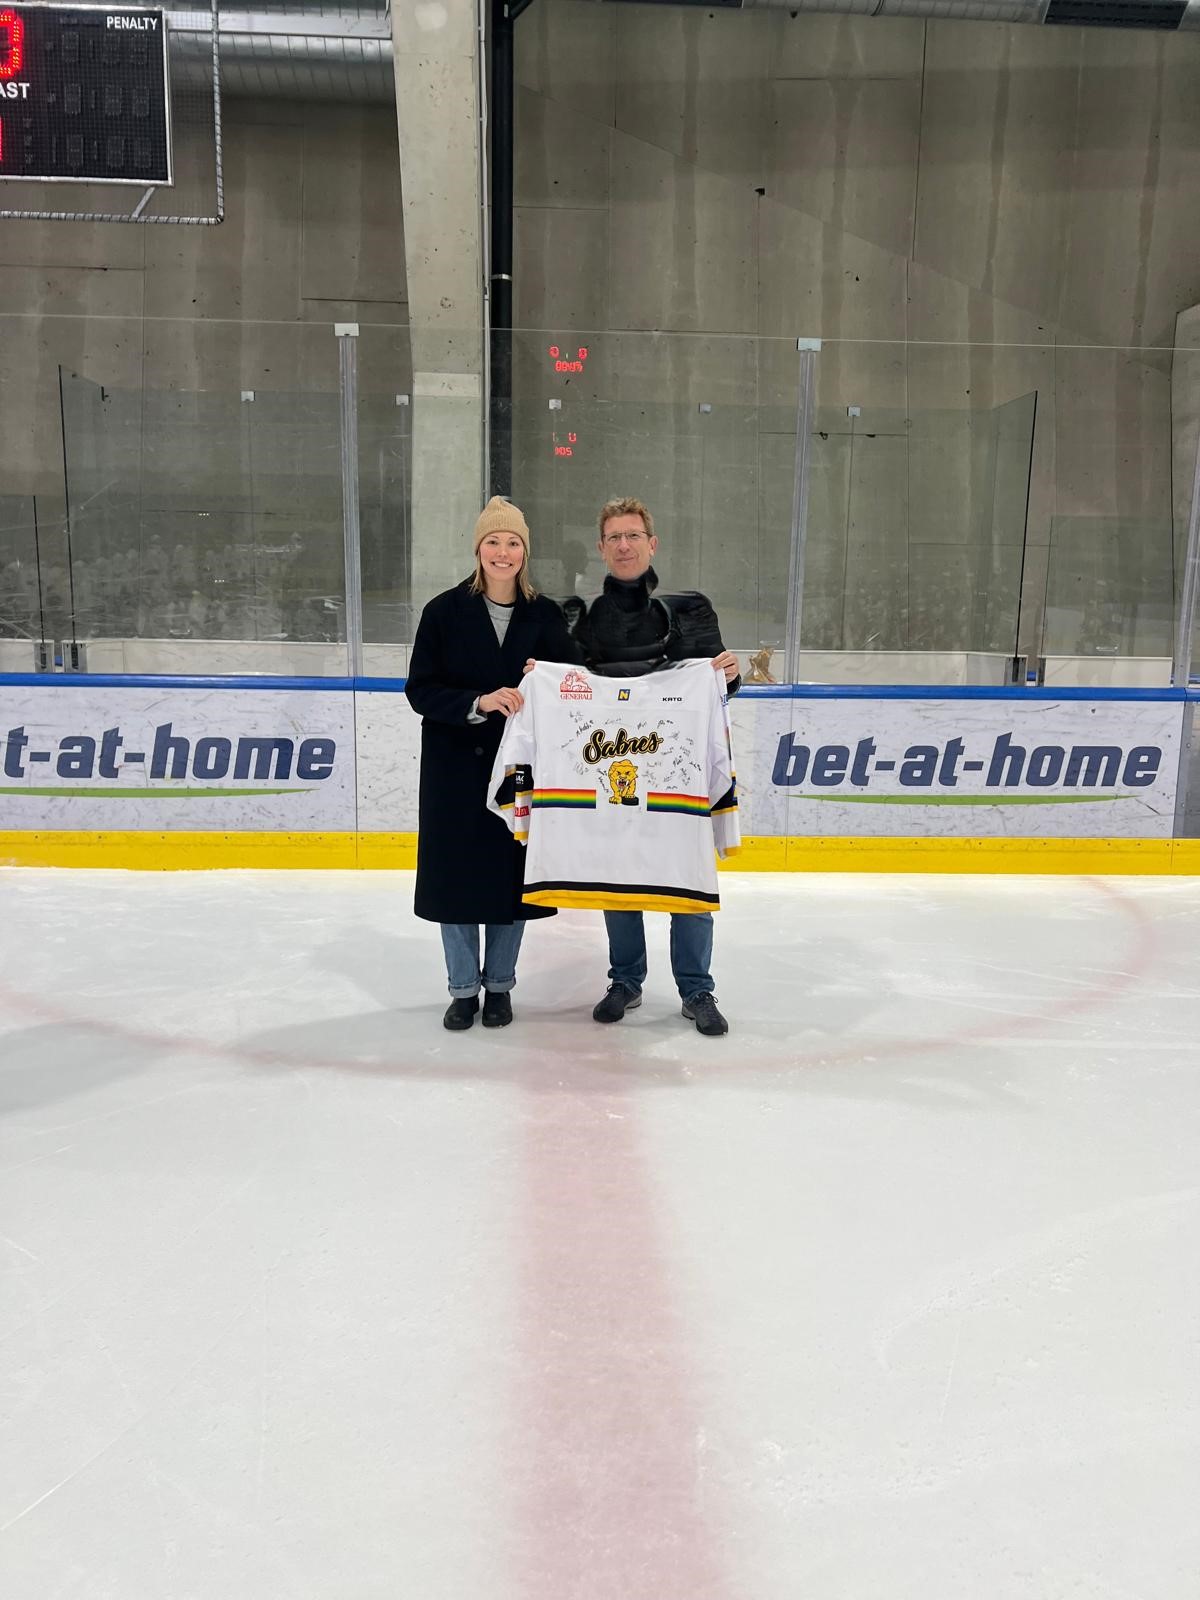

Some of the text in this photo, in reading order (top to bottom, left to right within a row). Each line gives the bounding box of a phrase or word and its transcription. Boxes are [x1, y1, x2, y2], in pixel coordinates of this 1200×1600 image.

[106, 16, 157, 30] PENALTY
[4, 722, 336, 780] t-at-home
[583, 728, 664, 764] Sabres
[771, 731, 1162, 787] bet-at-home
